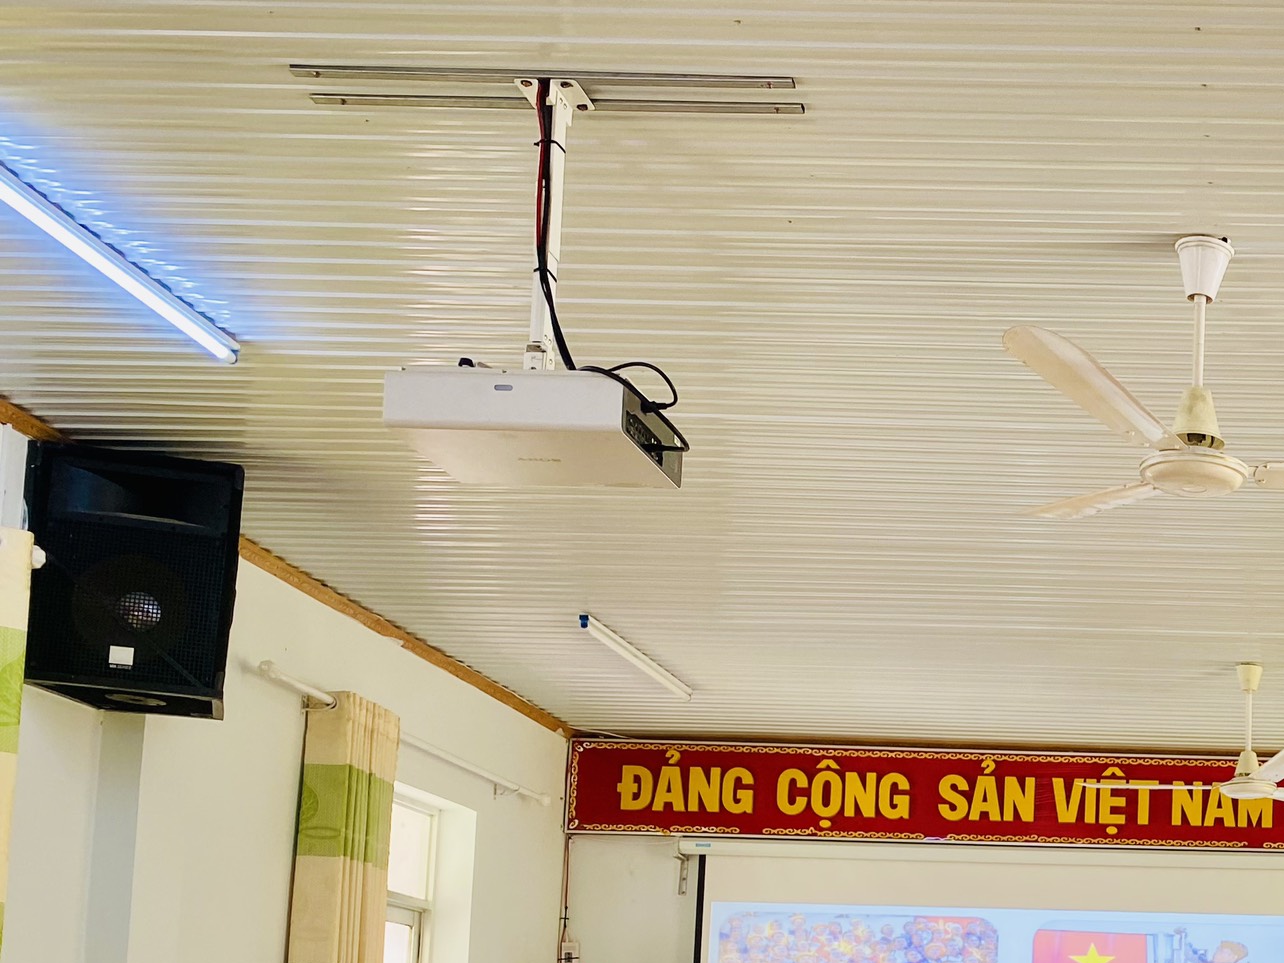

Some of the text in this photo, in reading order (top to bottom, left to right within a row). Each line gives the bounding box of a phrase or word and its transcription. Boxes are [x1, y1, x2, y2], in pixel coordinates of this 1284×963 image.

[617, 750, 754, 815] ĐẢNG
[776, 759, 910, 829] CỘNG
[938, 759, 1035, 822] SẢN
[1052, 766, 1159, 835] VIỆT
[1171, 781, 1274, 829] NAM
